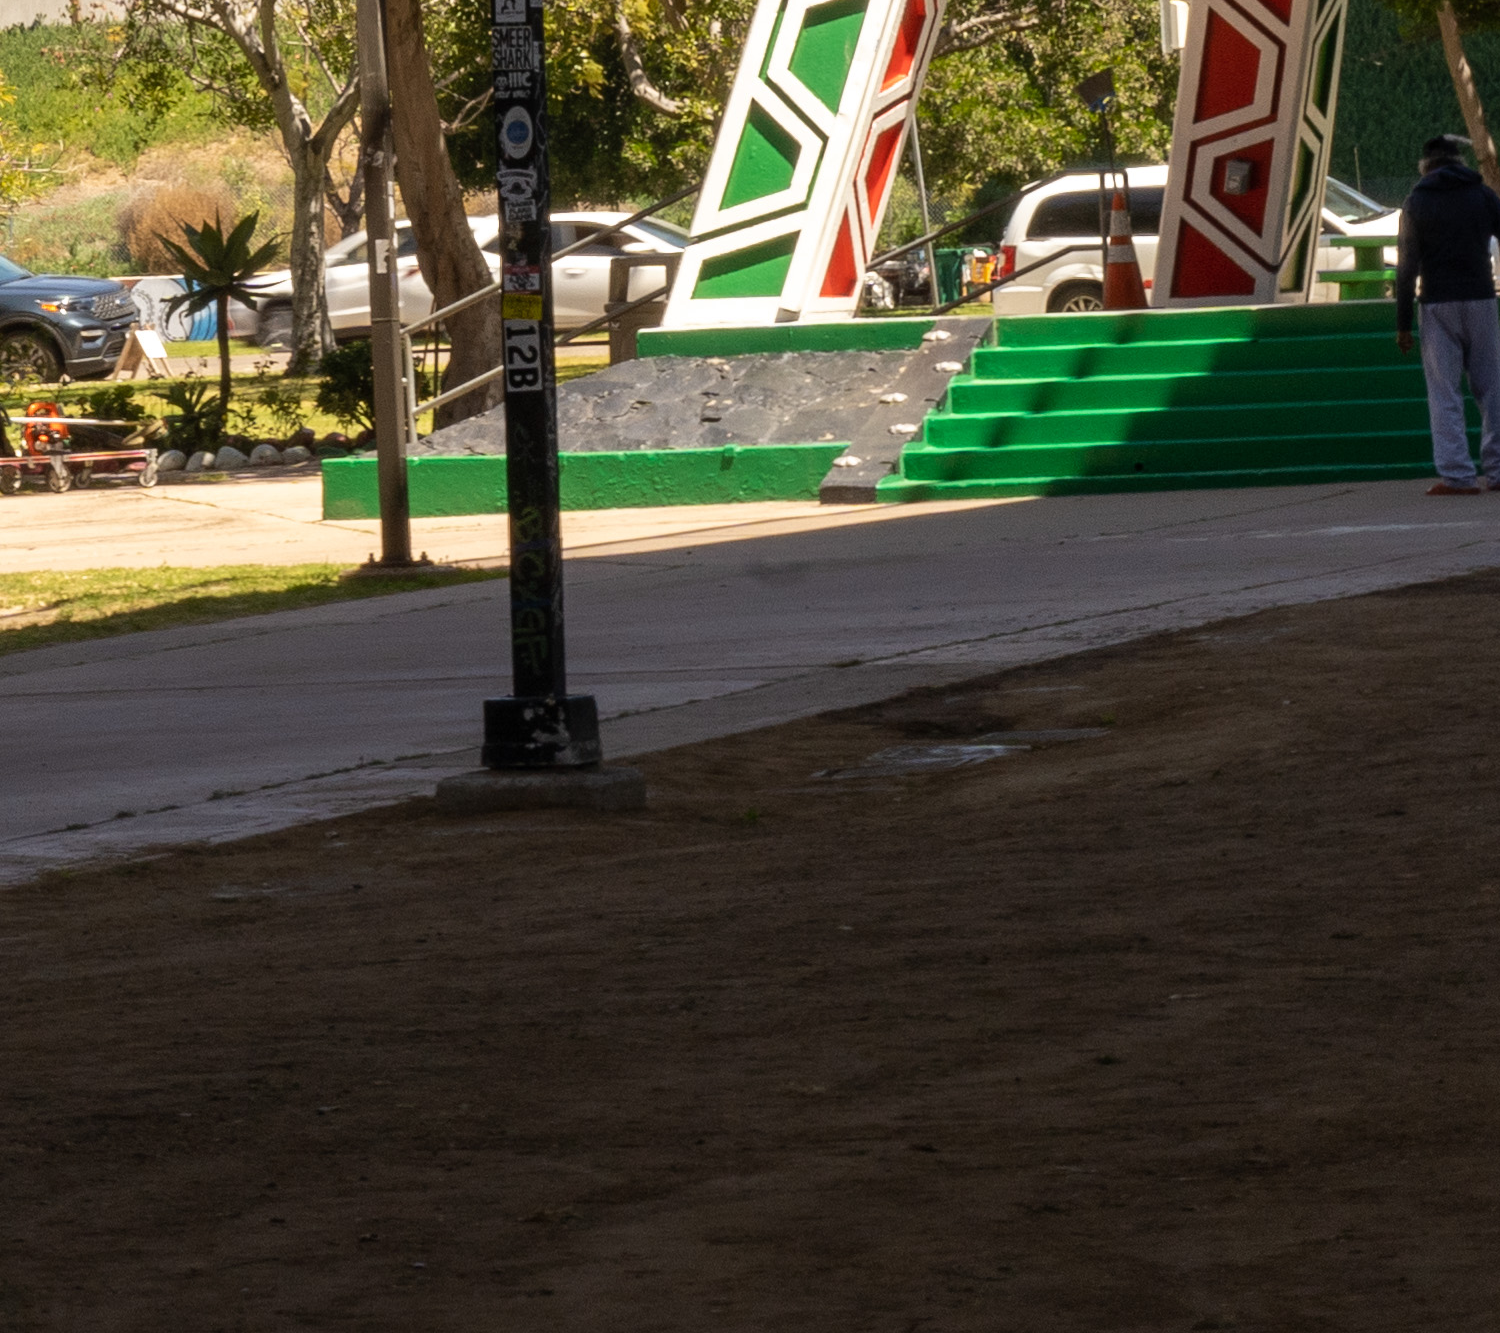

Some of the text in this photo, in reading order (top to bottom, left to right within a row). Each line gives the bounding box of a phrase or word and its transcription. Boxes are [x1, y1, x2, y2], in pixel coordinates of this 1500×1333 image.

[492, 27, 531, 48] SMEER
[492, 49, 532, 70] SHARK
[506, 326, 539, 388] 12B
